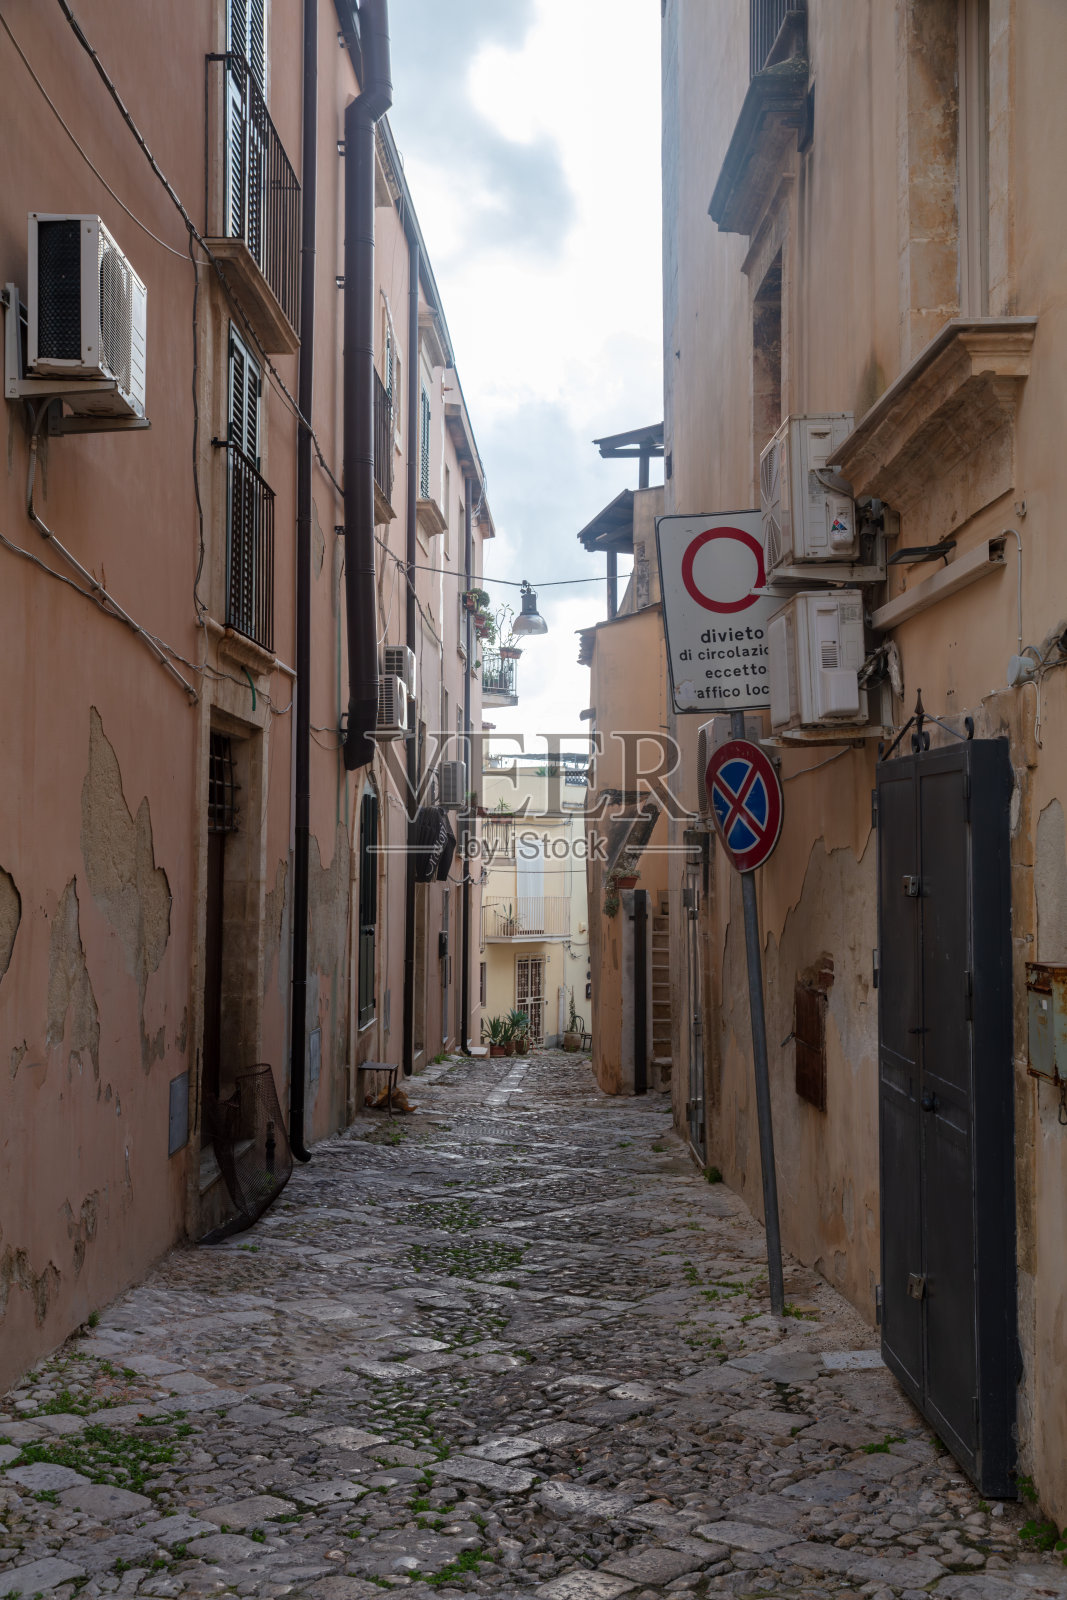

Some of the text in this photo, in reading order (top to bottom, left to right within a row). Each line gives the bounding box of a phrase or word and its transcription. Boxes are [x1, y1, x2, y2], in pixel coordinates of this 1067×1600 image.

[700, 626, 764, 644] divieto
[679, 649, 692, 661] di
[705, 663, 767, 679] eccetto
